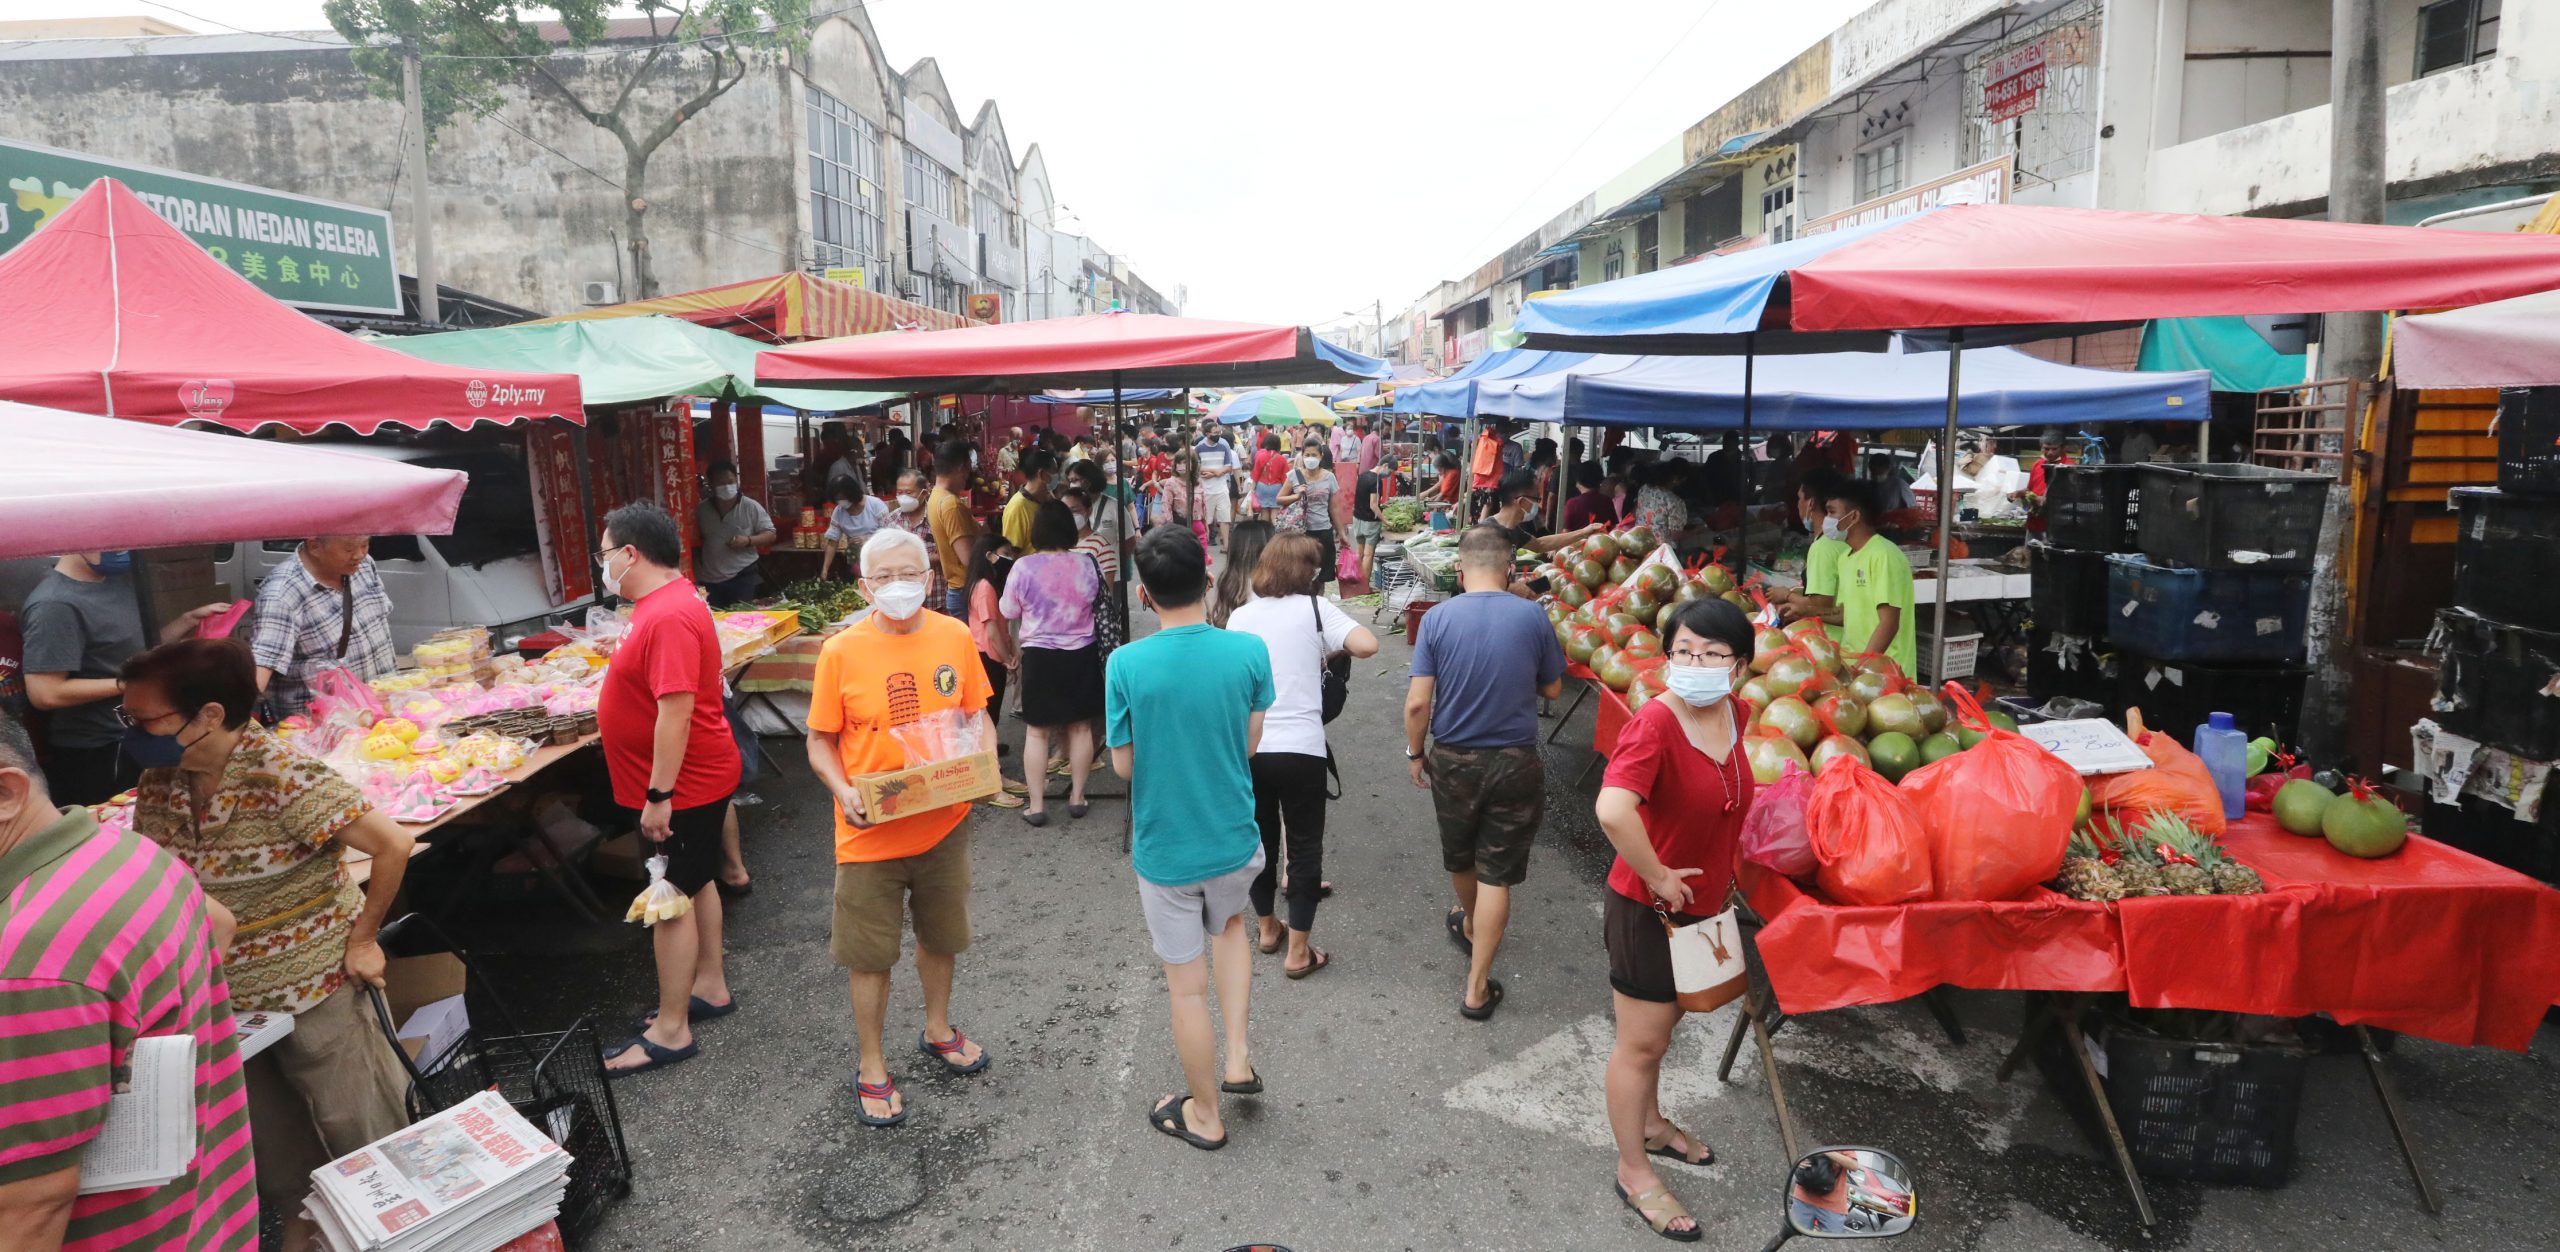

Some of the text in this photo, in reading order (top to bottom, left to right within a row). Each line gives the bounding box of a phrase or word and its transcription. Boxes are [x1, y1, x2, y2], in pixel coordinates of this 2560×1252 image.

[2010, 53, 2024, 69] FOR
[2024, 40, 2046, 64] RENT
[1985, 67, 2044, 108] 016-656 7893
[136, 191, 381, 258] TORAN MEDAN SELERA
[241, 250, 361, 289] 美食中心
[491, 383, 545, 406] 2ply.my
[0, 656, 19, 668] ACH
[2043, 739, 2070, 752] 2
